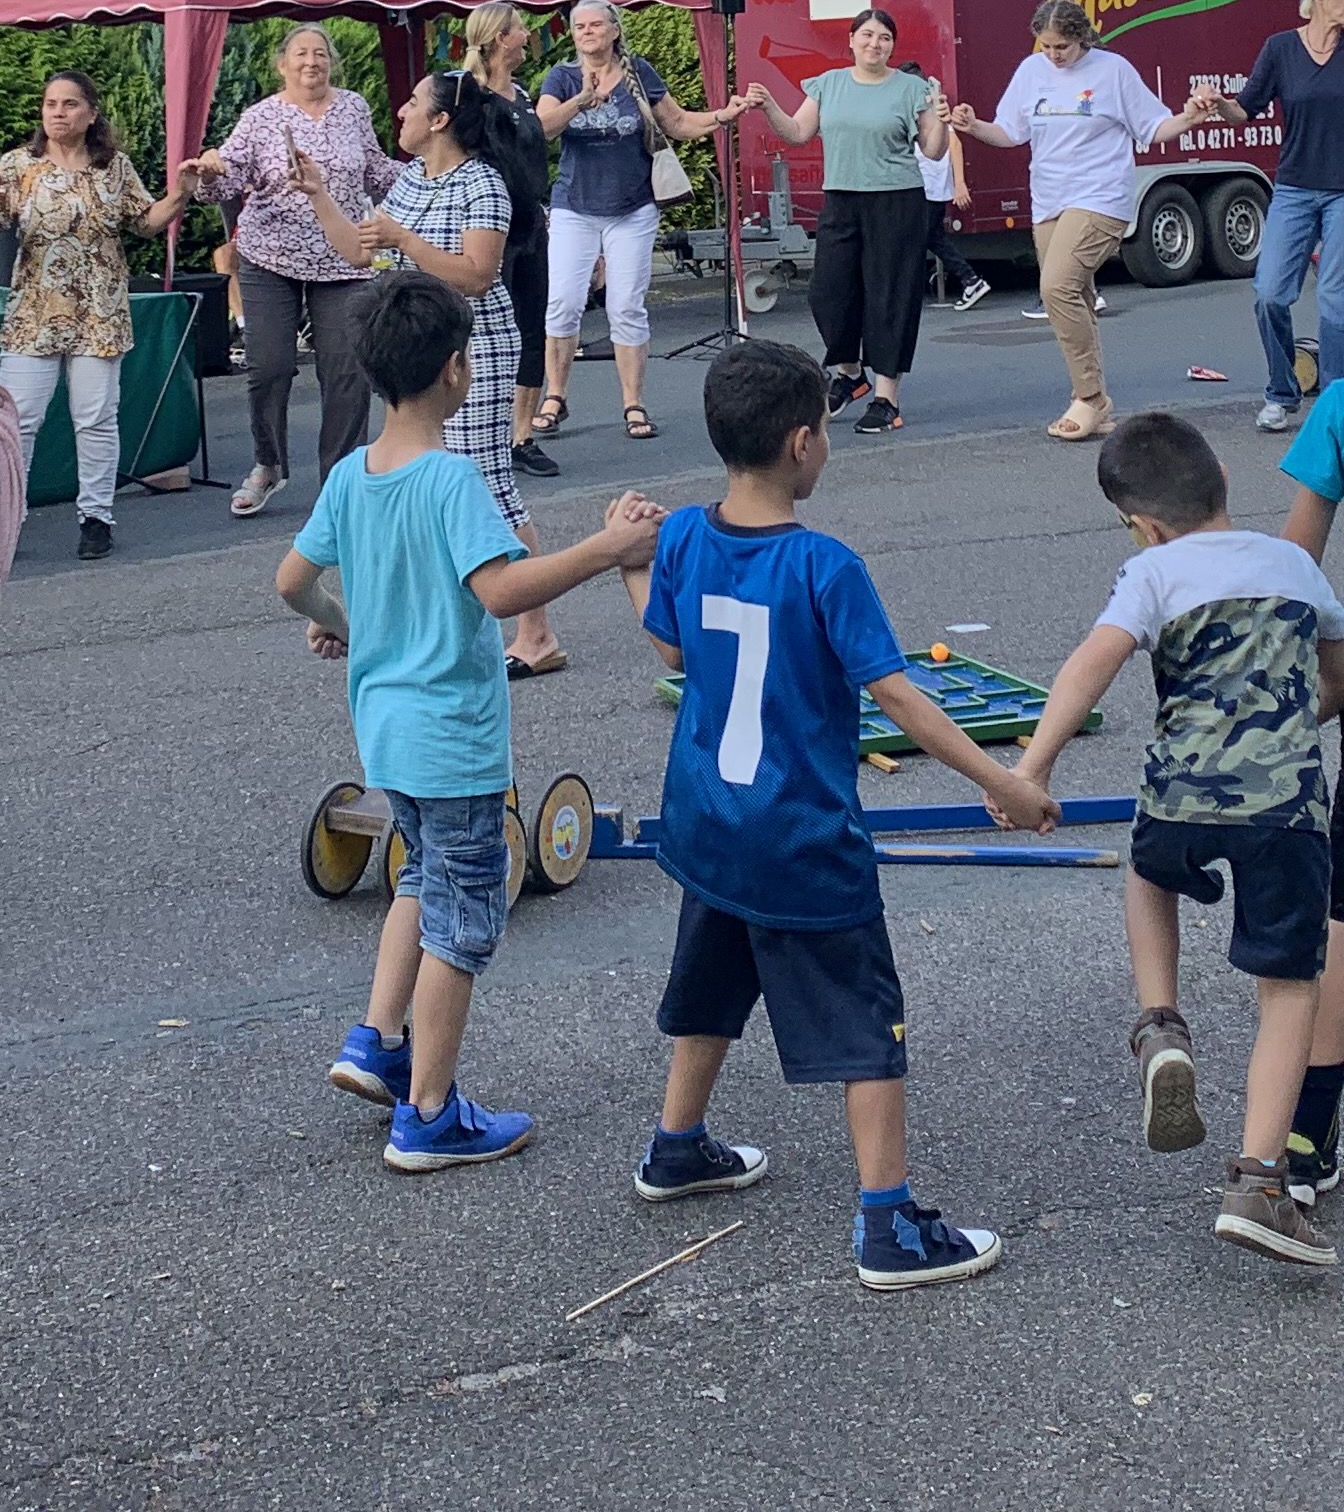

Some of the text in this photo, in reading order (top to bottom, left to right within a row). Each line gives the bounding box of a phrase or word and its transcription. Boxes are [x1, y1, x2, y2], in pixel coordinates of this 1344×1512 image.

[1197, 129, 1206, 150] 0
[1207, 128, 1221, 150] 42
[1222, 127, 1236, 149] 71
[1244, 126, 1257, 147] 93
[1260, 125, 1273, 146] 73
[1274, 124, 1283, 145] 0
[702, 594, 770, 785] 7
